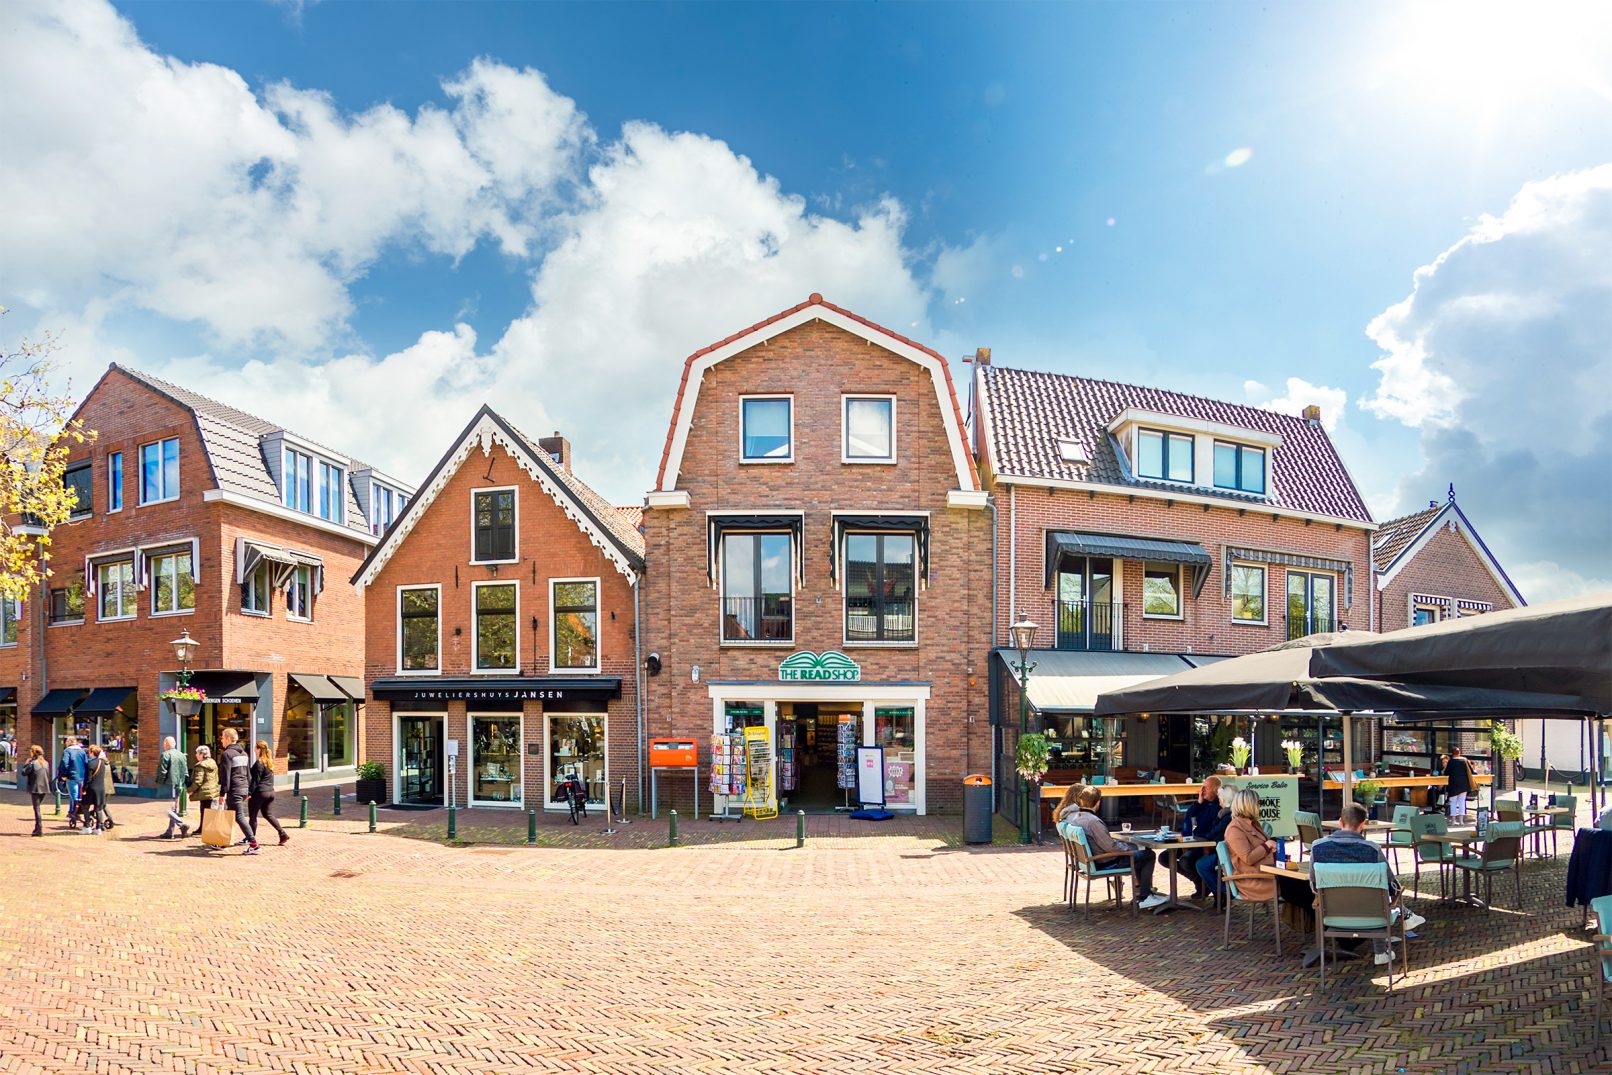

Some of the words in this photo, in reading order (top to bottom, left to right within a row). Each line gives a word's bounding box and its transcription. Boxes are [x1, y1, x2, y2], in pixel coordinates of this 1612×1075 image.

[780, 669, 799, 680] THE
[800, 669, 832, 680] READ
[832, 669, 859, 680] SHOP
[513, 691, 564, 699] JANSEN
[1258, 798, 1280, 808] MOKE
